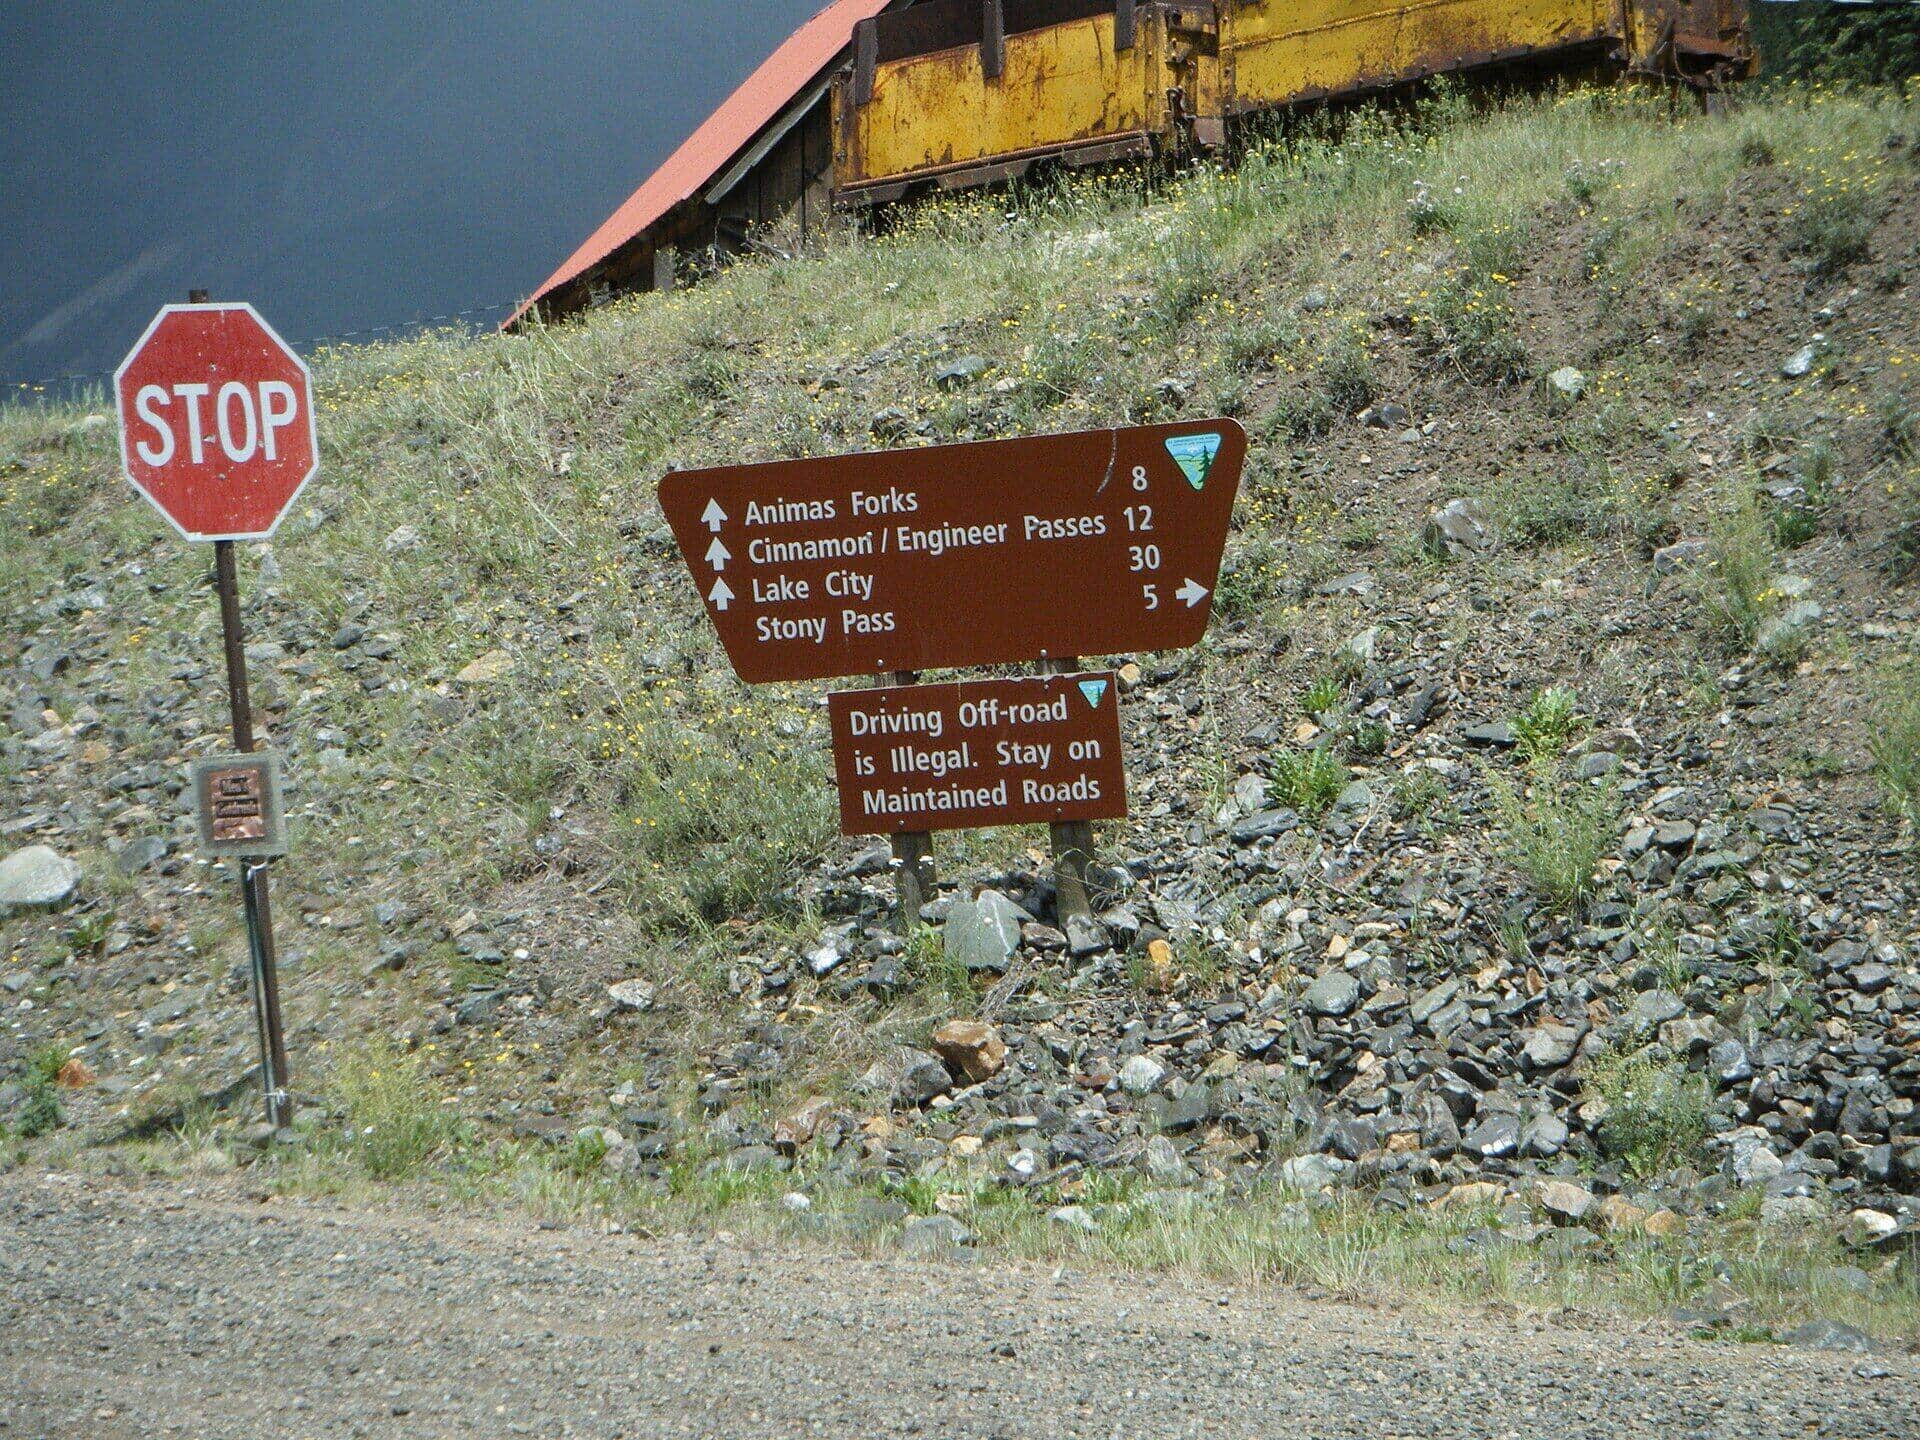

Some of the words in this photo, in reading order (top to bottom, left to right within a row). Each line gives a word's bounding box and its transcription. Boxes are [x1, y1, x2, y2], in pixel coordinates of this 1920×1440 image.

[135, 380, 298, 467] STOP
[744, 497, 836, 526] Animas
[851, 486, 918, 516] Forks
[1131, 465, 1148, 491] 8
[748, 531, 874, 564] Cinnamon
[897, 521, 1008, 556] Engineer
[1023, 514, 1107, 541] Passes
[1123, 504, 1154, 532] 12
[752, 574, 810, 603] Lake
[825, 569, 874, 601] City
[1128, 544, 1161, 572] 30
[756, 616, 827, 644] Stony
[842, 609, 896, 634] Pass
[1143, 583, 1158, 610] 5
[850, 706, 943, 738] Driving
[958, 693, 1068, 728] Off-road
[854, 749, 876, 776] is
[890, 741, 979, 778] Illegal.
[996, 740, 1051, 770] Stay
[1068, 739, 1101, 761] on
[862, 779, 1008, 815] Maintained
[1022, 773, 1101, 804] Roads
